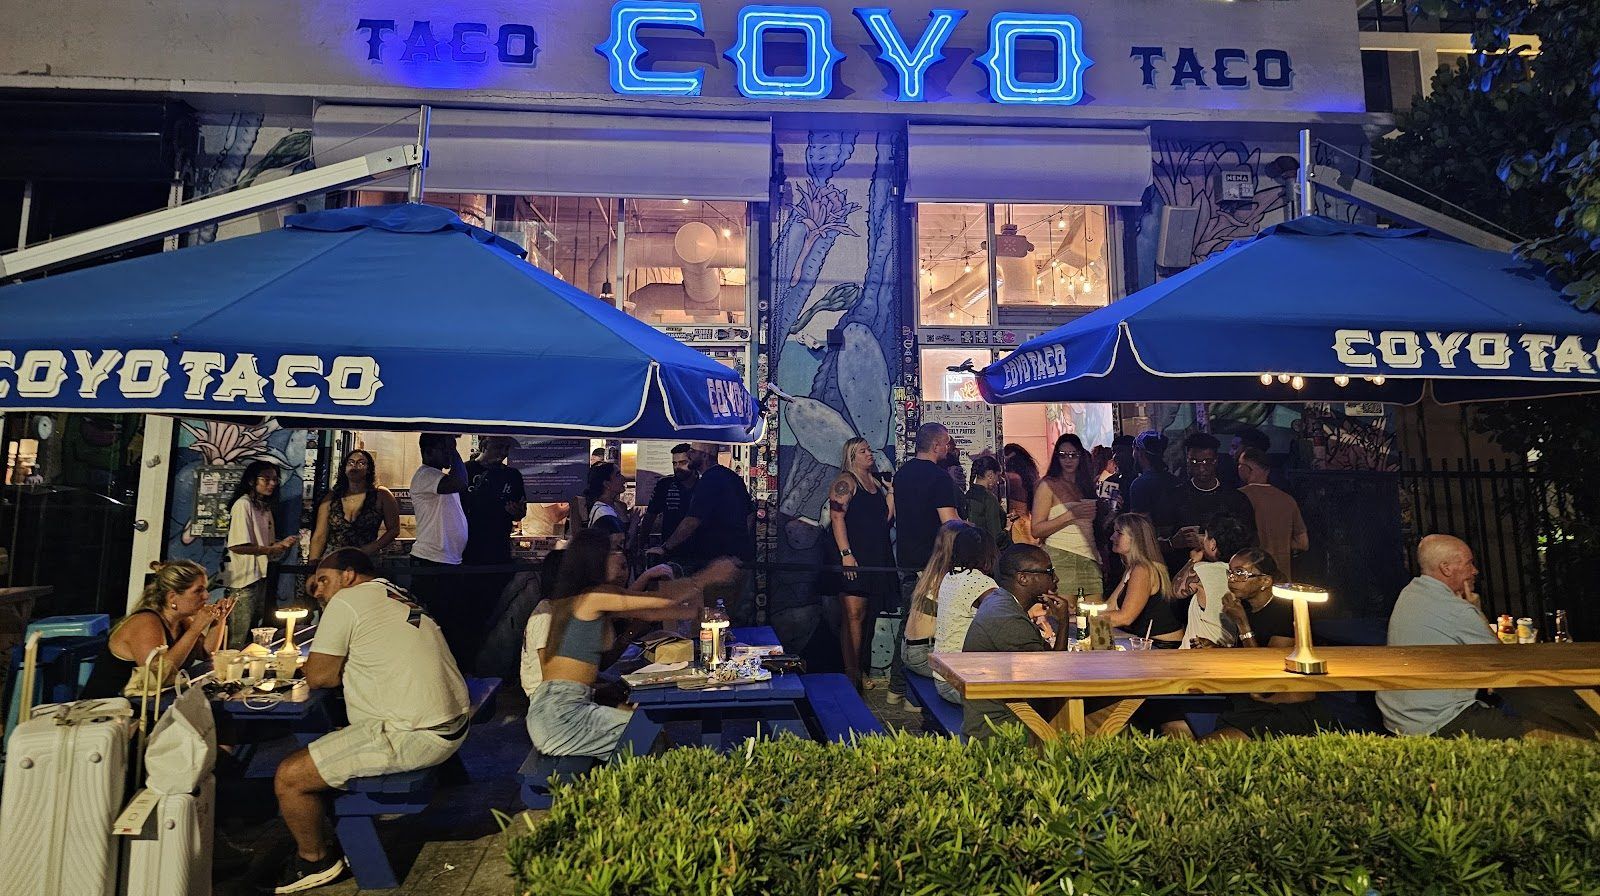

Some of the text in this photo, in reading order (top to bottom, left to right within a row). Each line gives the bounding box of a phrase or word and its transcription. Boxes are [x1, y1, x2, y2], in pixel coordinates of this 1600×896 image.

[356, 0, 1294, 105] TACO COYO TACO
[1002, 343, 1067, 390] COYO TACO
[1331, 329, 1600, 375] COYO TA
[179, 351, 384, 406] TACO
[706, 377, 745, 418] COYO
